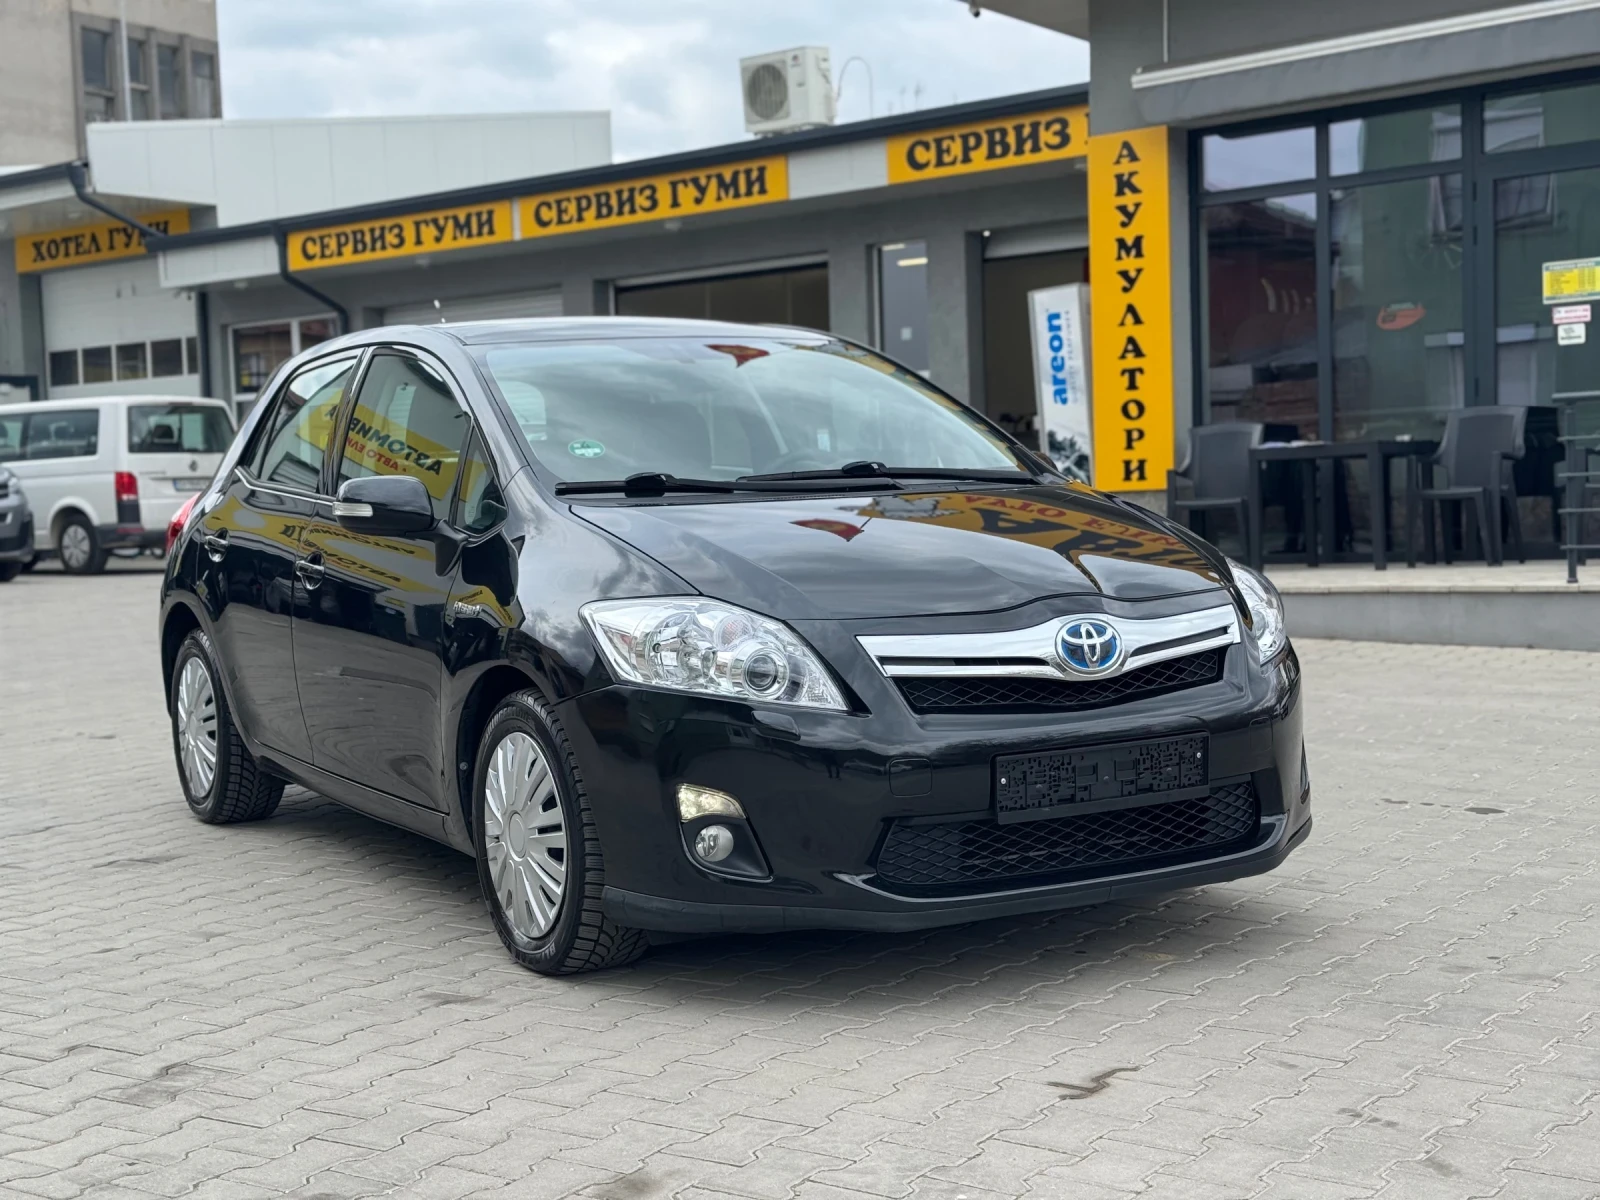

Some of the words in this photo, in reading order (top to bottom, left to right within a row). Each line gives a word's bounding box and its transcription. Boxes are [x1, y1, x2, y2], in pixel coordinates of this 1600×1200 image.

[906, 117, 1072, 171] СЕРВИЗ
[533, 184, 660, 228] СЕРВИЗ
[669, 165, 769, 209] ГУМИ
[32, 232, 102, 262] ХОТЕЛ
[301, 223, 406, 261] СЕРВИЗ
[413, 209, 496, 246] ГУМИ
[1113, 140, 1149, 483] АКУМУЛАТОРИ
[1047, 312, 1069, 405] areon
